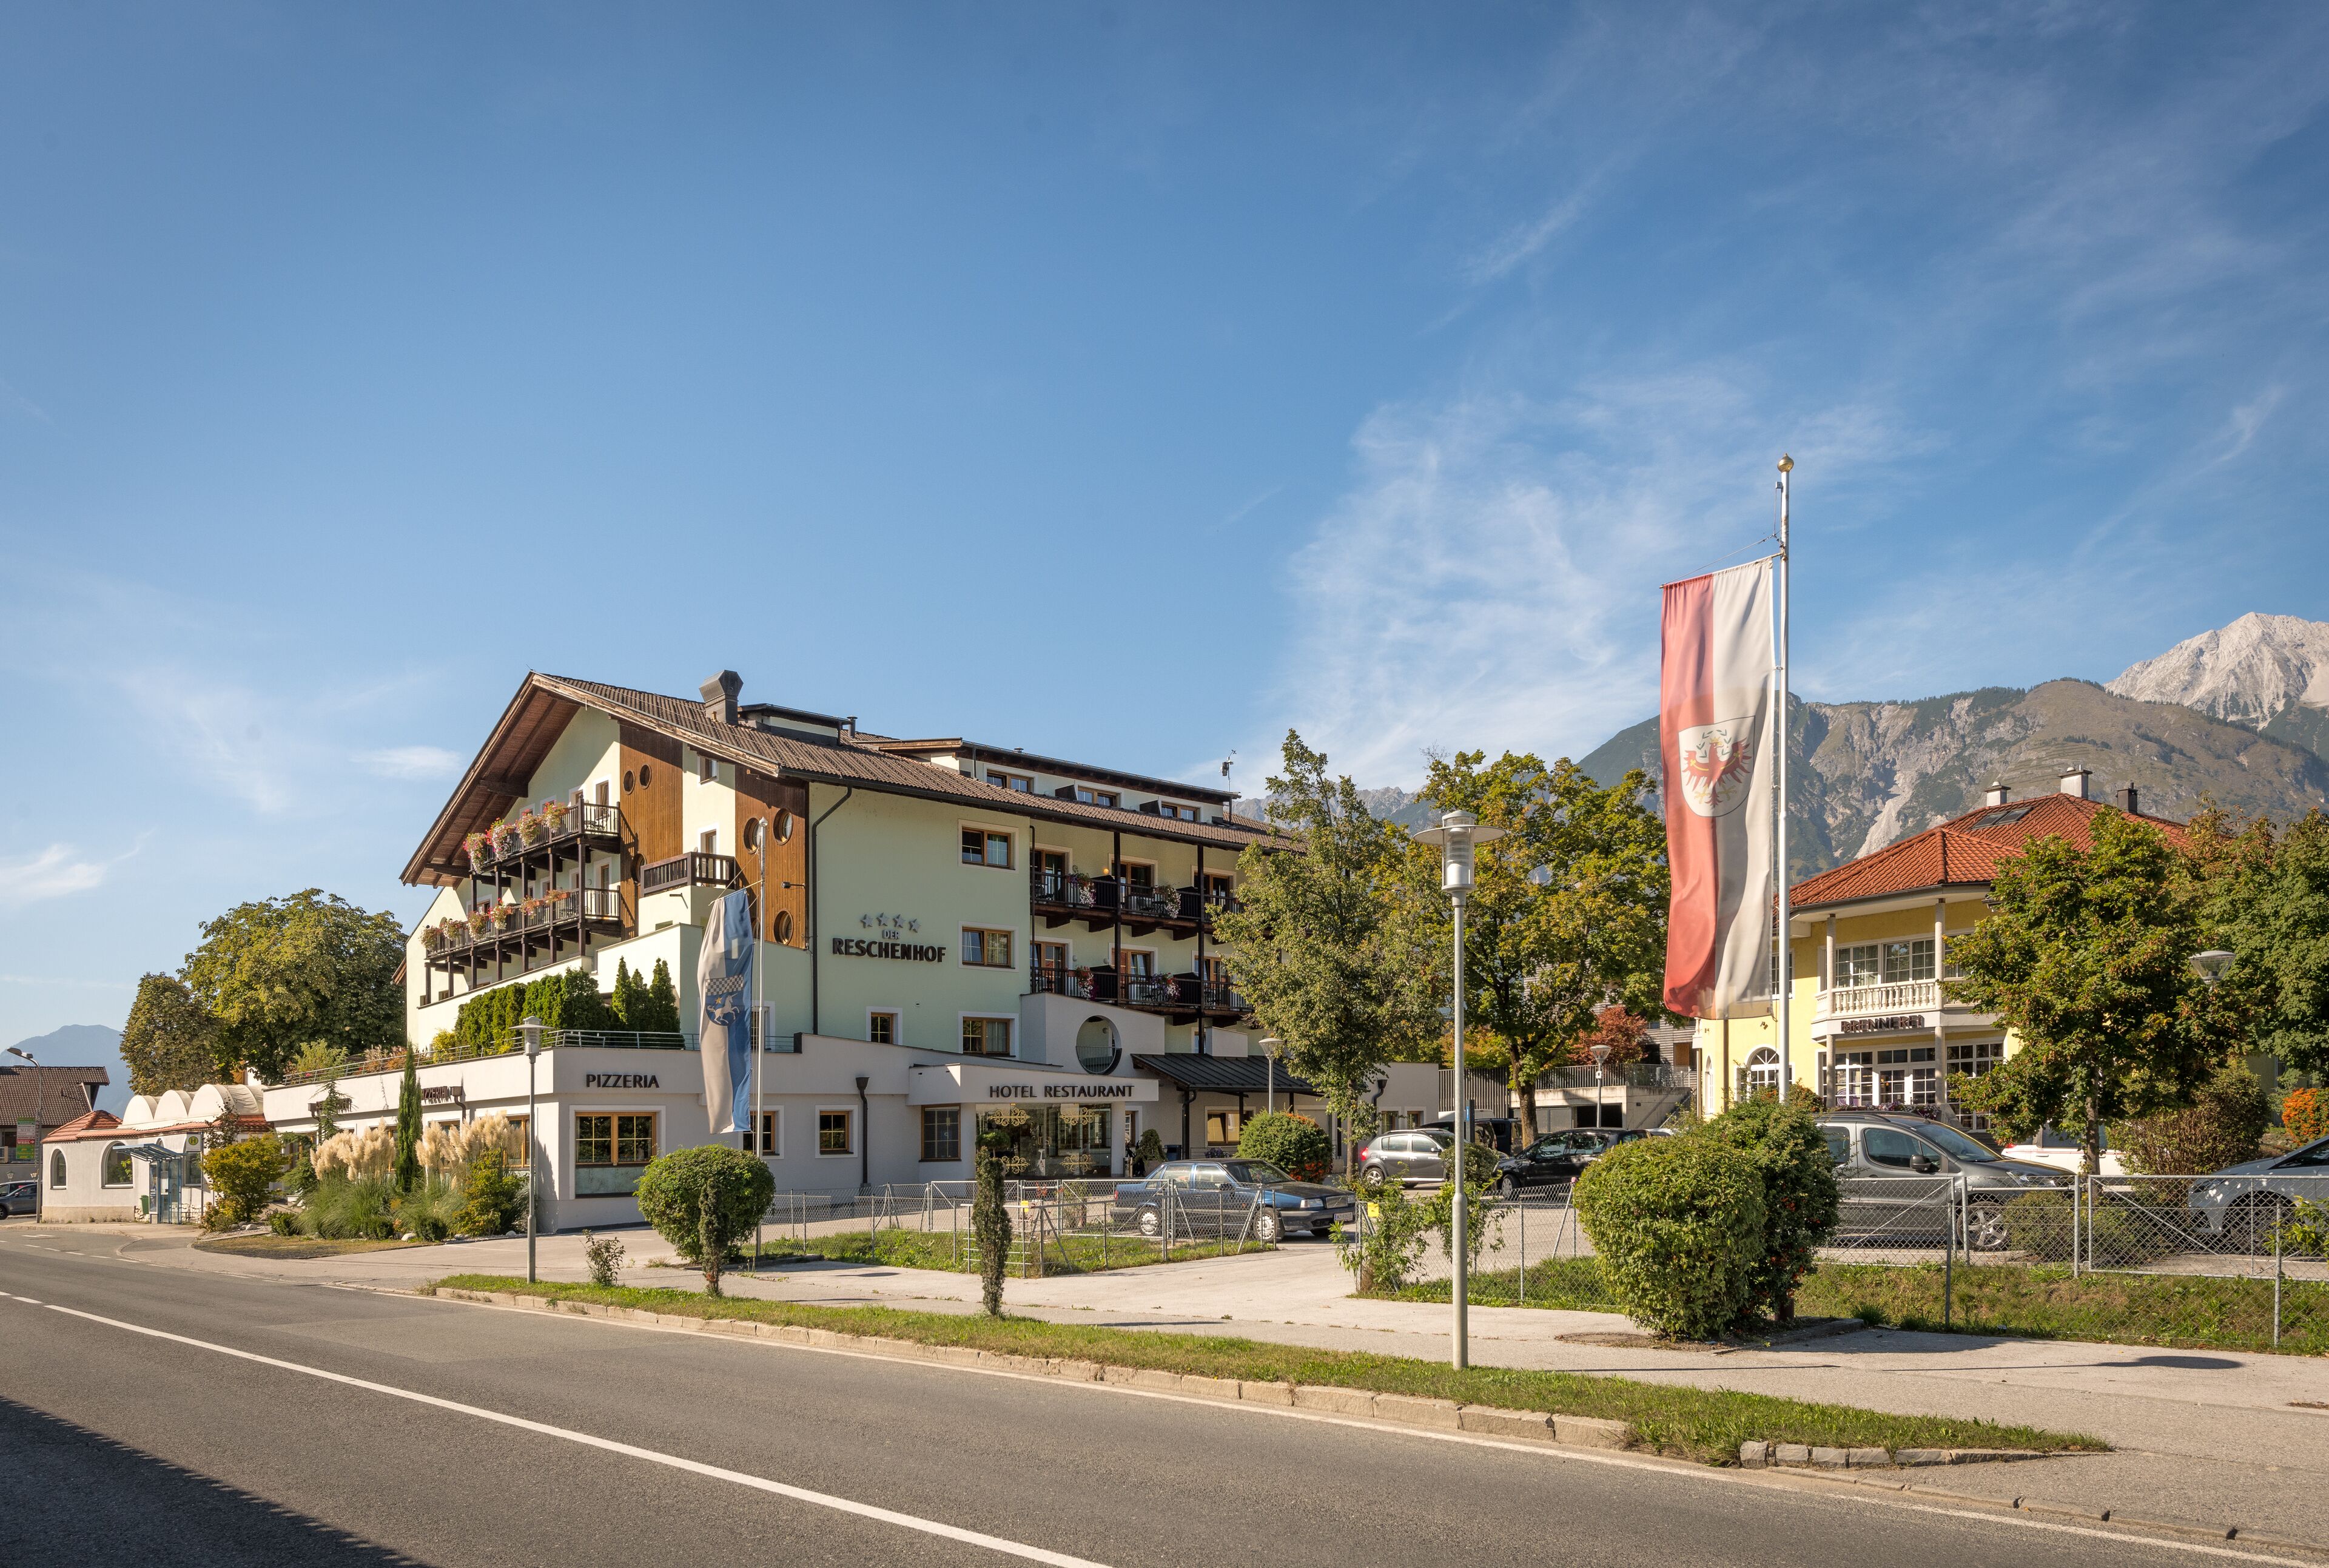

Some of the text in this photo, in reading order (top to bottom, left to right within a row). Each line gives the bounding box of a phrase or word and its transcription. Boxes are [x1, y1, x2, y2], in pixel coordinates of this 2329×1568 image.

[882, 929, 900, 940] DER
[833, 938, 946, 962] RESCHENHOF
[1841, 1015, 1924, 1032] BRENNEREI
[586, 1074, 660, 1088] PIZZERIA
[422, 1086, 447, 1100] IZZERIA
[989, 1085, 1135, 1097] HOTEL RESTAURANT
